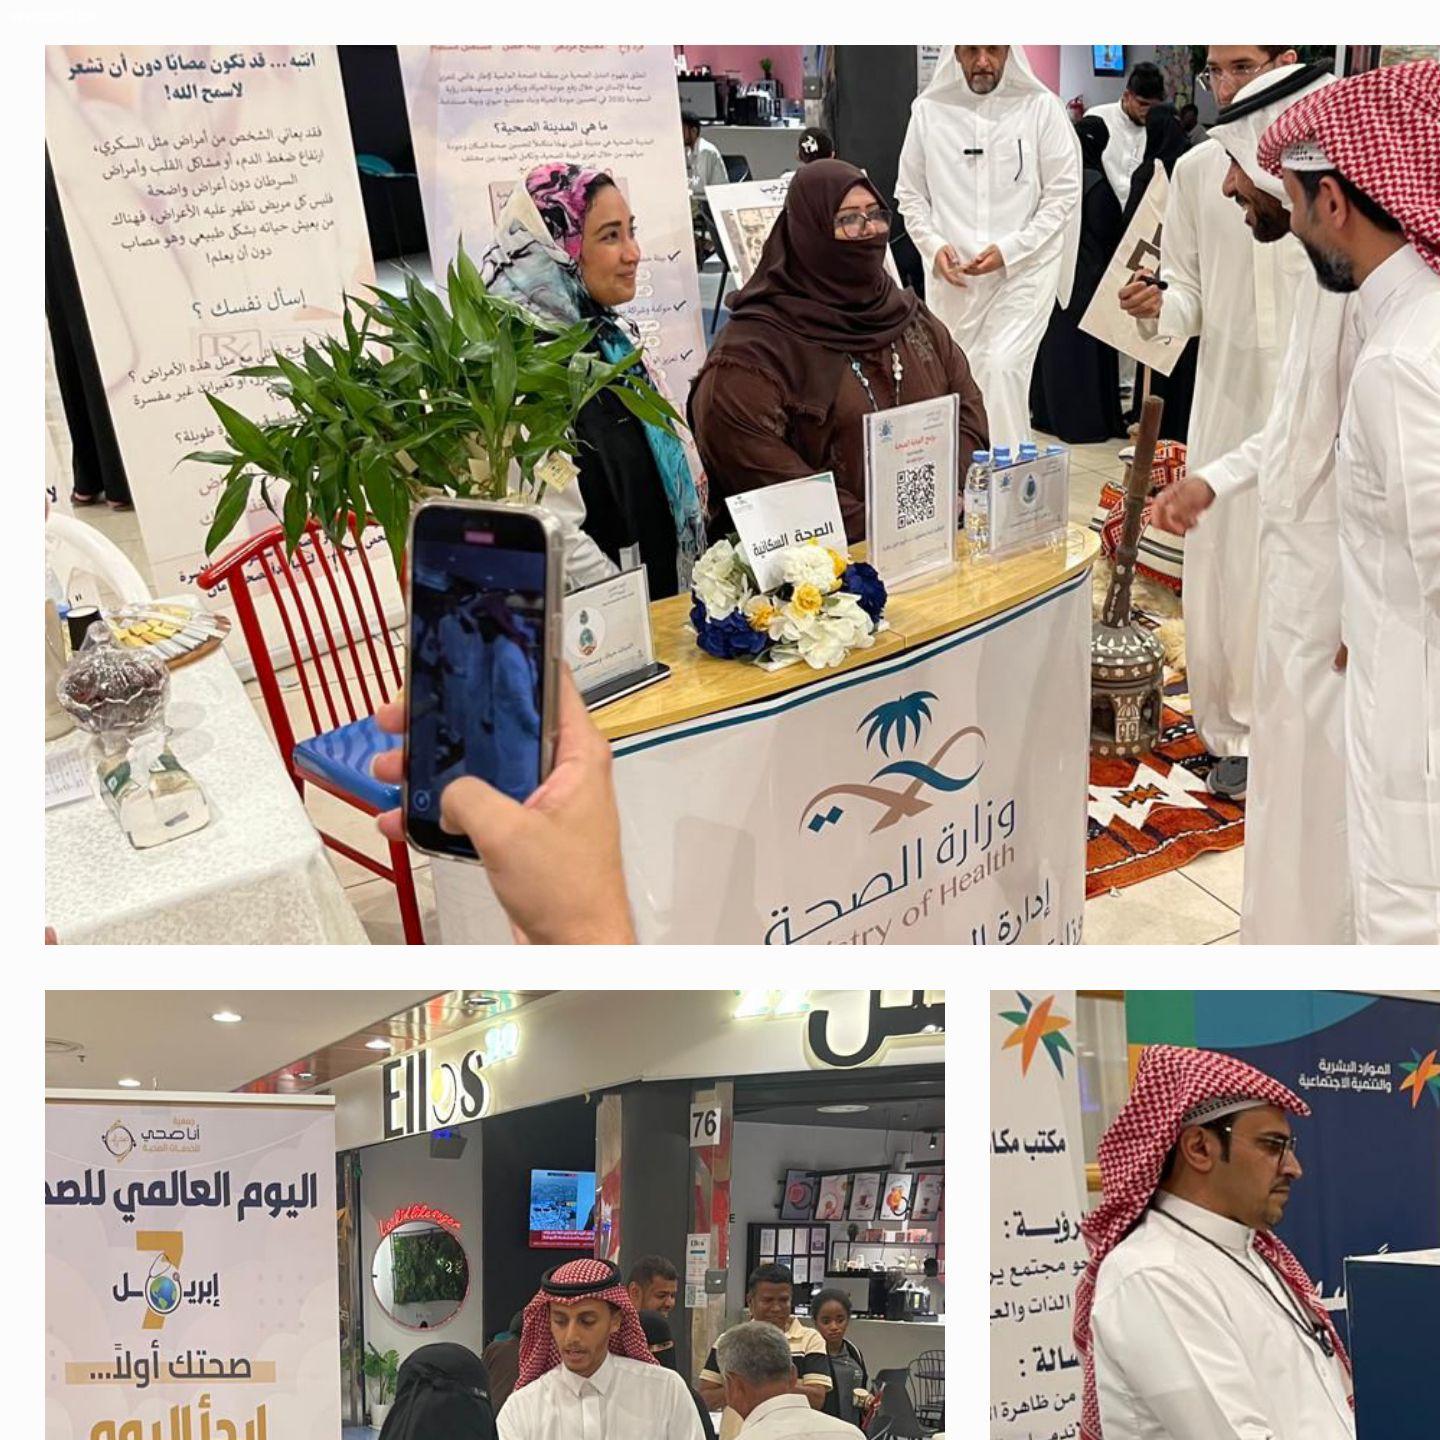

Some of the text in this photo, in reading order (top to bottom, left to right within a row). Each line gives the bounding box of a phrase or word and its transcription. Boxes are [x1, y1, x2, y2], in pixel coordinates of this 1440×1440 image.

[68, 58, 104, 81] تشعر
[109, 56, 128, 77] أن
[132, 60, 162, 77] دون
[210, 54, 246, 75] تكون
[249, 54, 266, 69] قد
[148, 134, 169, 151] مثل
[211, 134, 226, 148] من
[229, 127, 273, 146] الشخص
[147, 181, 189, 198] واضحة
[229, 179, 251, 193] دون
[253, 175, 298, 190] السرطان
[121, 234, 161, 252] مصاب
[252, 246, 273, 259] دون
[210, 295, 262, 319] نفسك
[794, 521, 834, 543] الصحة
[936, 798, 1016, 867] وزارة
[764, 837, 924, 945] الصحة
[902, 887, 933, 928] of
[940, 842, 1016, 906] Health
[1318, 1058, 1391, 1077] الموارد البشرية
[383, 1049, 485, 1140] Ellos
[1299, 1074, 1392, 1093] والتنمية الاجتماعية
[693, 1110, 717, 1138] 76
[1023, 1129, 1066, 1164] مكتب
[45, 1168, 105, 1206] للص
[113, 1170, 231, 1223] العالمي
[237, 1172, 318, 1223] اليوم
[136, 1231, 184, 1330] 7
[1013, 1257, 1066, 1288] مجتمع
[168, 1350, 252, 1380] صحتك
[1001, 1392, 1076, 1422] من ظاهرة
